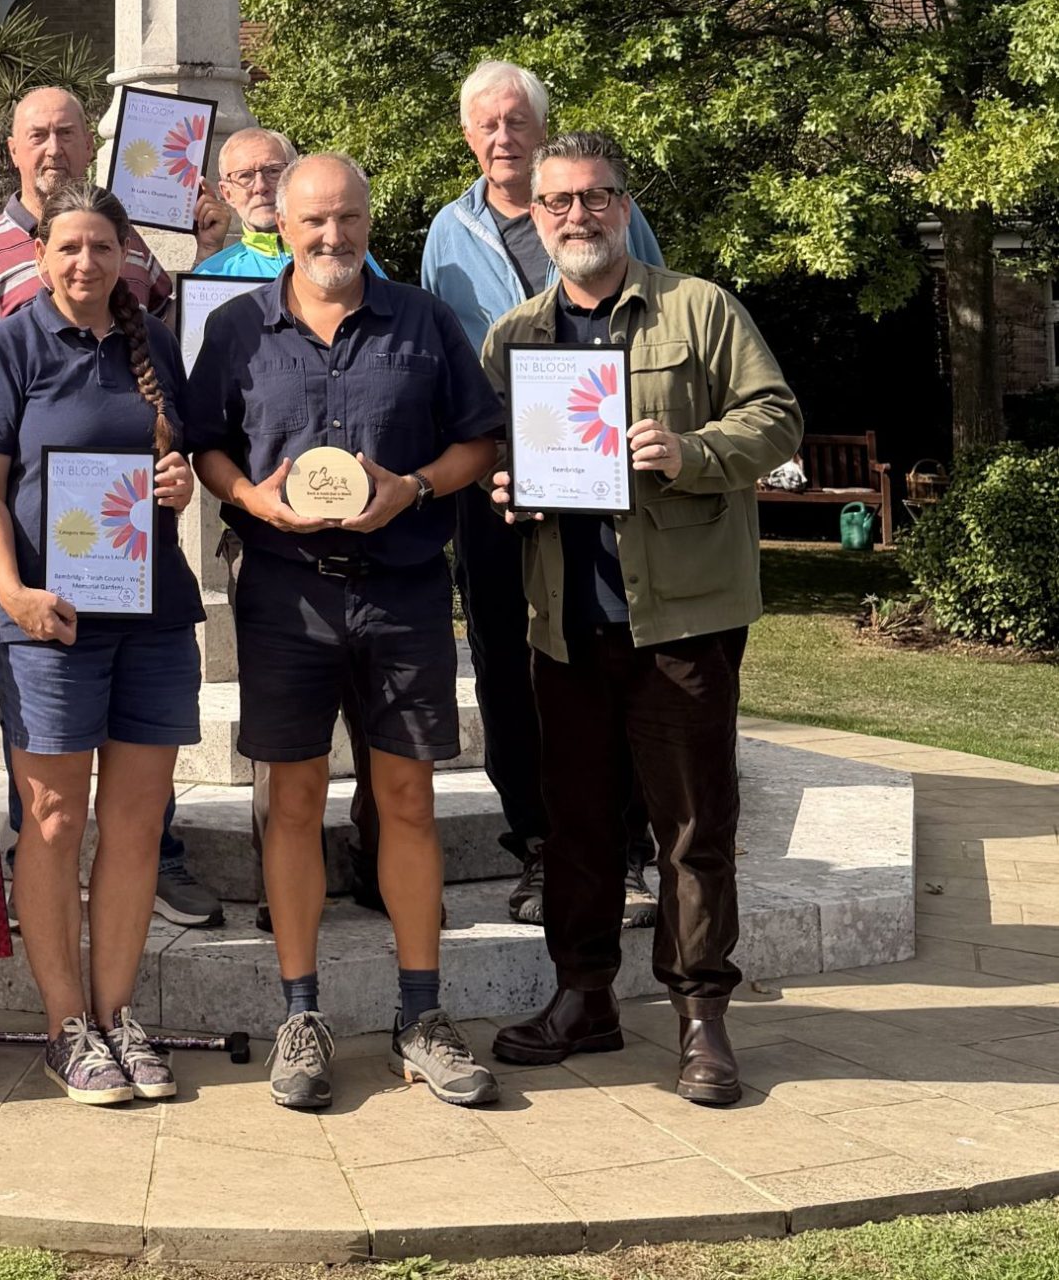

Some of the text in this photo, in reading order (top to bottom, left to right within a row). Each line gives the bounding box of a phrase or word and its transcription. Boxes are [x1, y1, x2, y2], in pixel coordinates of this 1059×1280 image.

[128, 103, 175, 117] IN BLOOM
[515, 362, 576, 373] IN BLOOM
[52, 465, 109, 476] IN BLOOM
[552, 466, 585, 474] Bembridge
